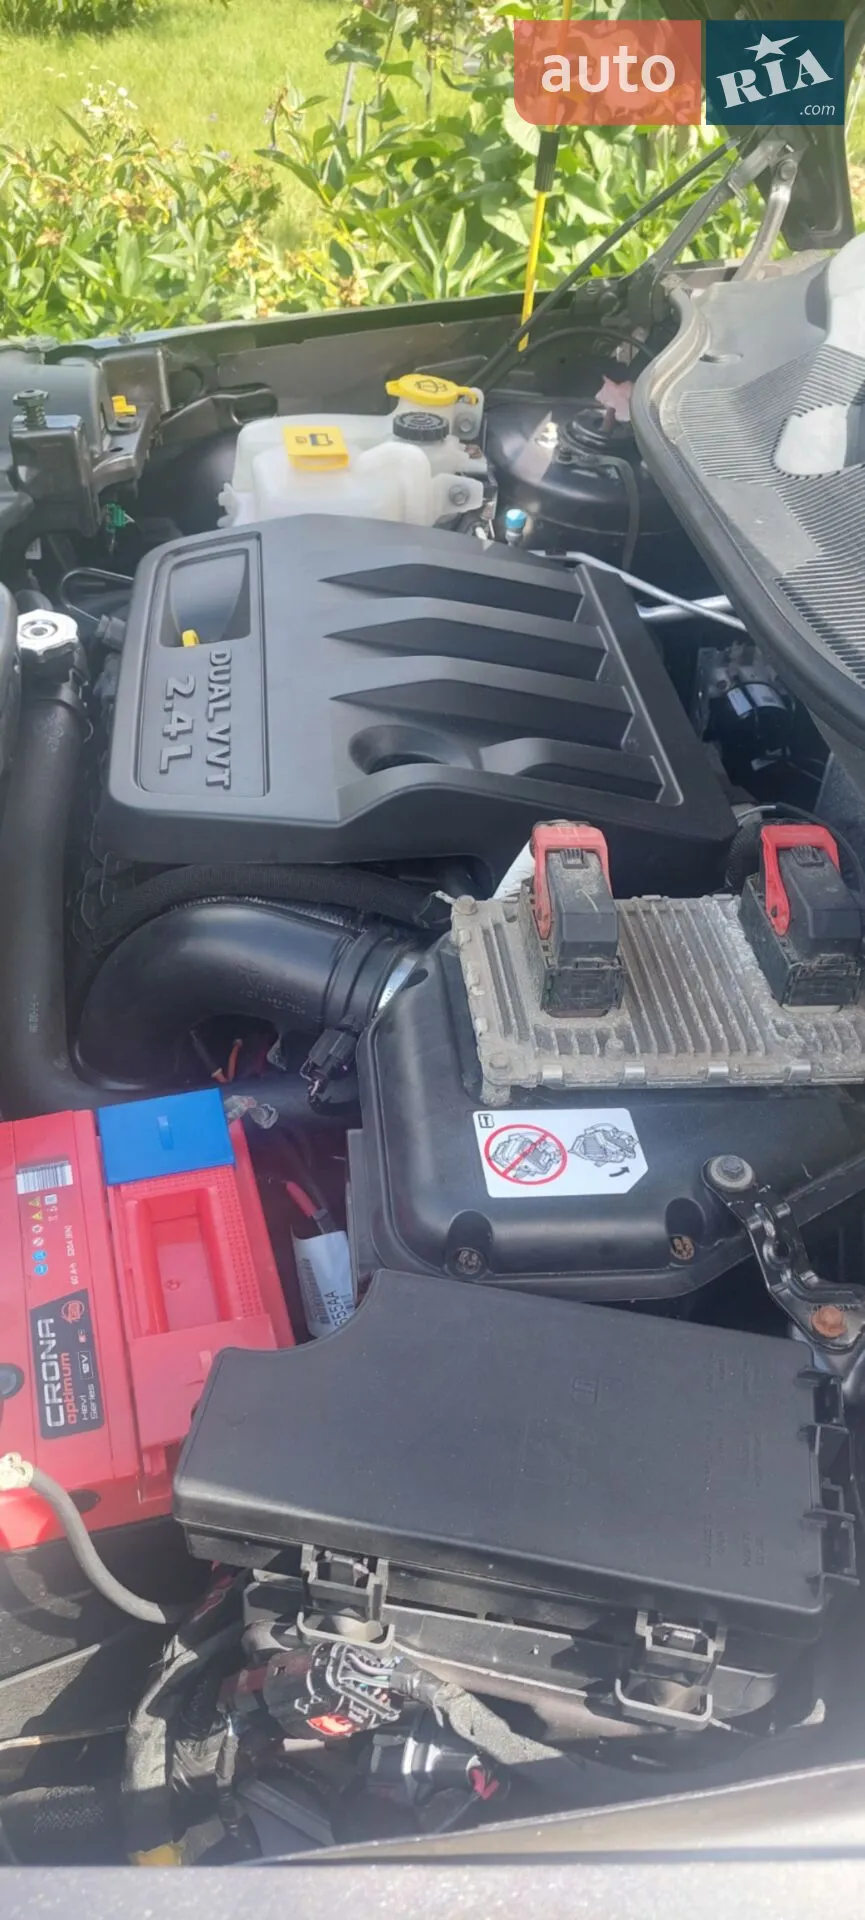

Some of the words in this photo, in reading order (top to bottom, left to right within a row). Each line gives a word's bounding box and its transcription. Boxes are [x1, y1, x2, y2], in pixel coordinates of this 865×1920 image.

[207, 649, 232, 722] DUAL
[159, 674, 196, 774] 2.4L
[206, 722, 231, 790] VVT
[38, 1318, 65, 1427] CRONA
[60, 1352, 79, 1425] optimum
[87, 1383, 98, 1420] Series
